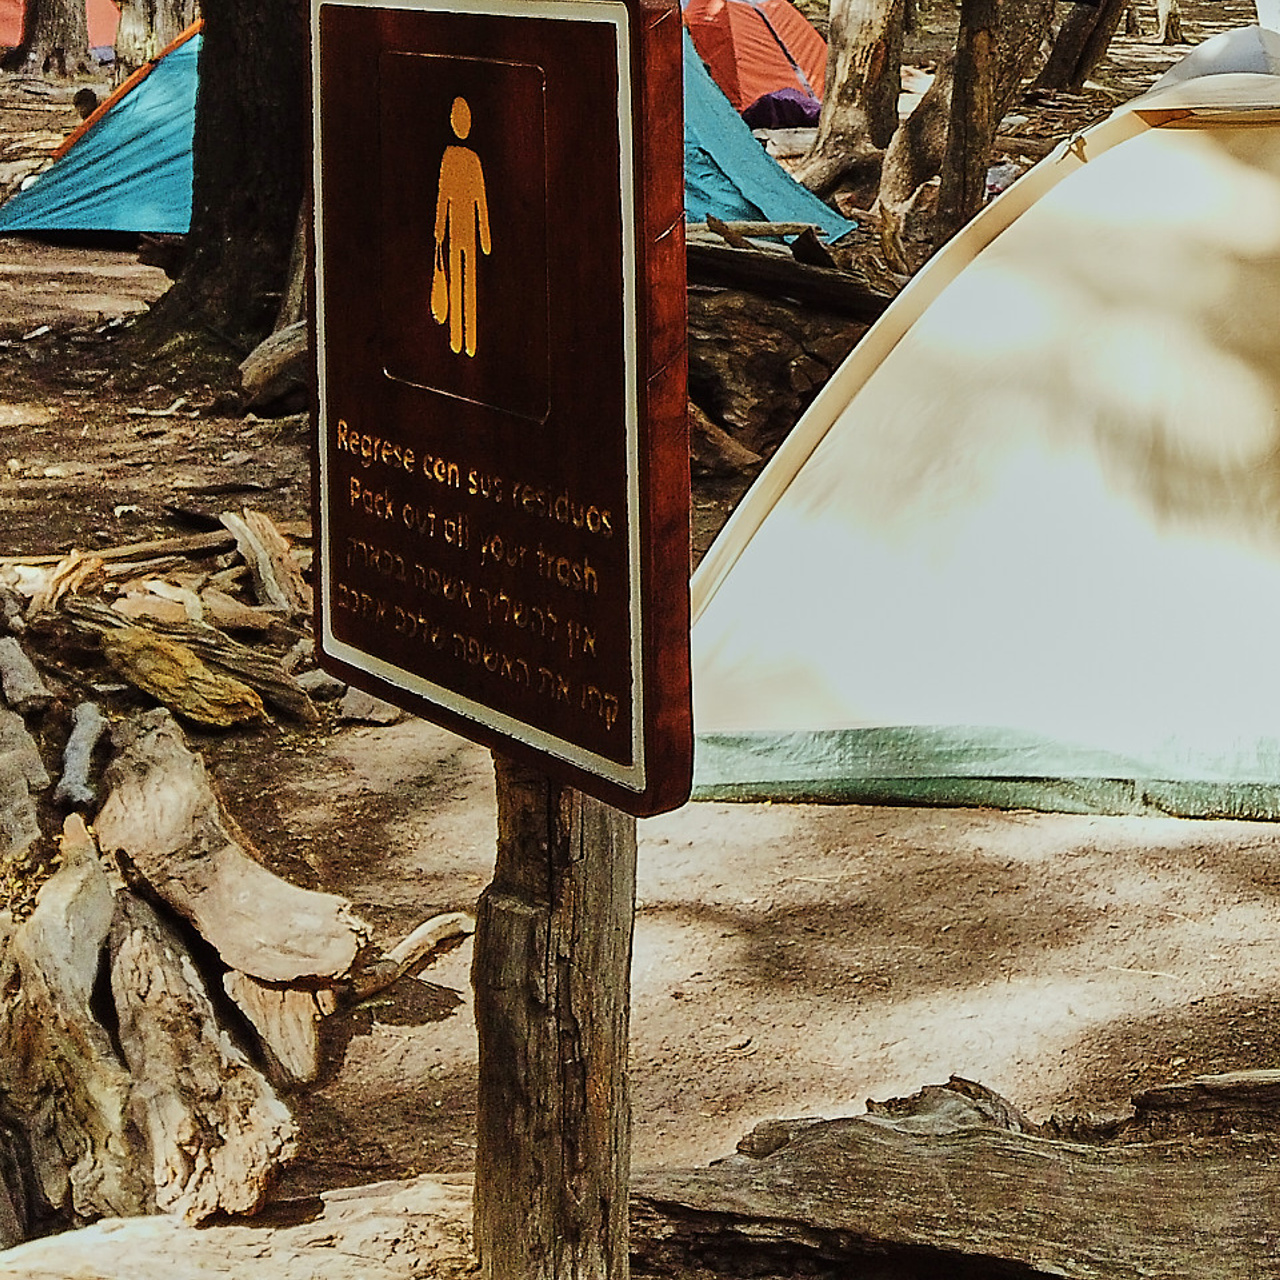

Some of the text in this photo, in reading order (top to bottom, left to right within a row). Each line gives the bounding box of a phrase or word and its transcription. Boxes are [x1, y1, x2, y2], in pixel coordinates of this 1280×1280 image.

[336, 418, 613, 538] Regrese con sus residuos
[350, 476, 599, 596] Pack out all your trash
[415, 563, 472, 609] אשפה
[567, 619, 598, 659] אין
[538, 665, 571, 705] את
[581, 683, 619, 731] קחו
